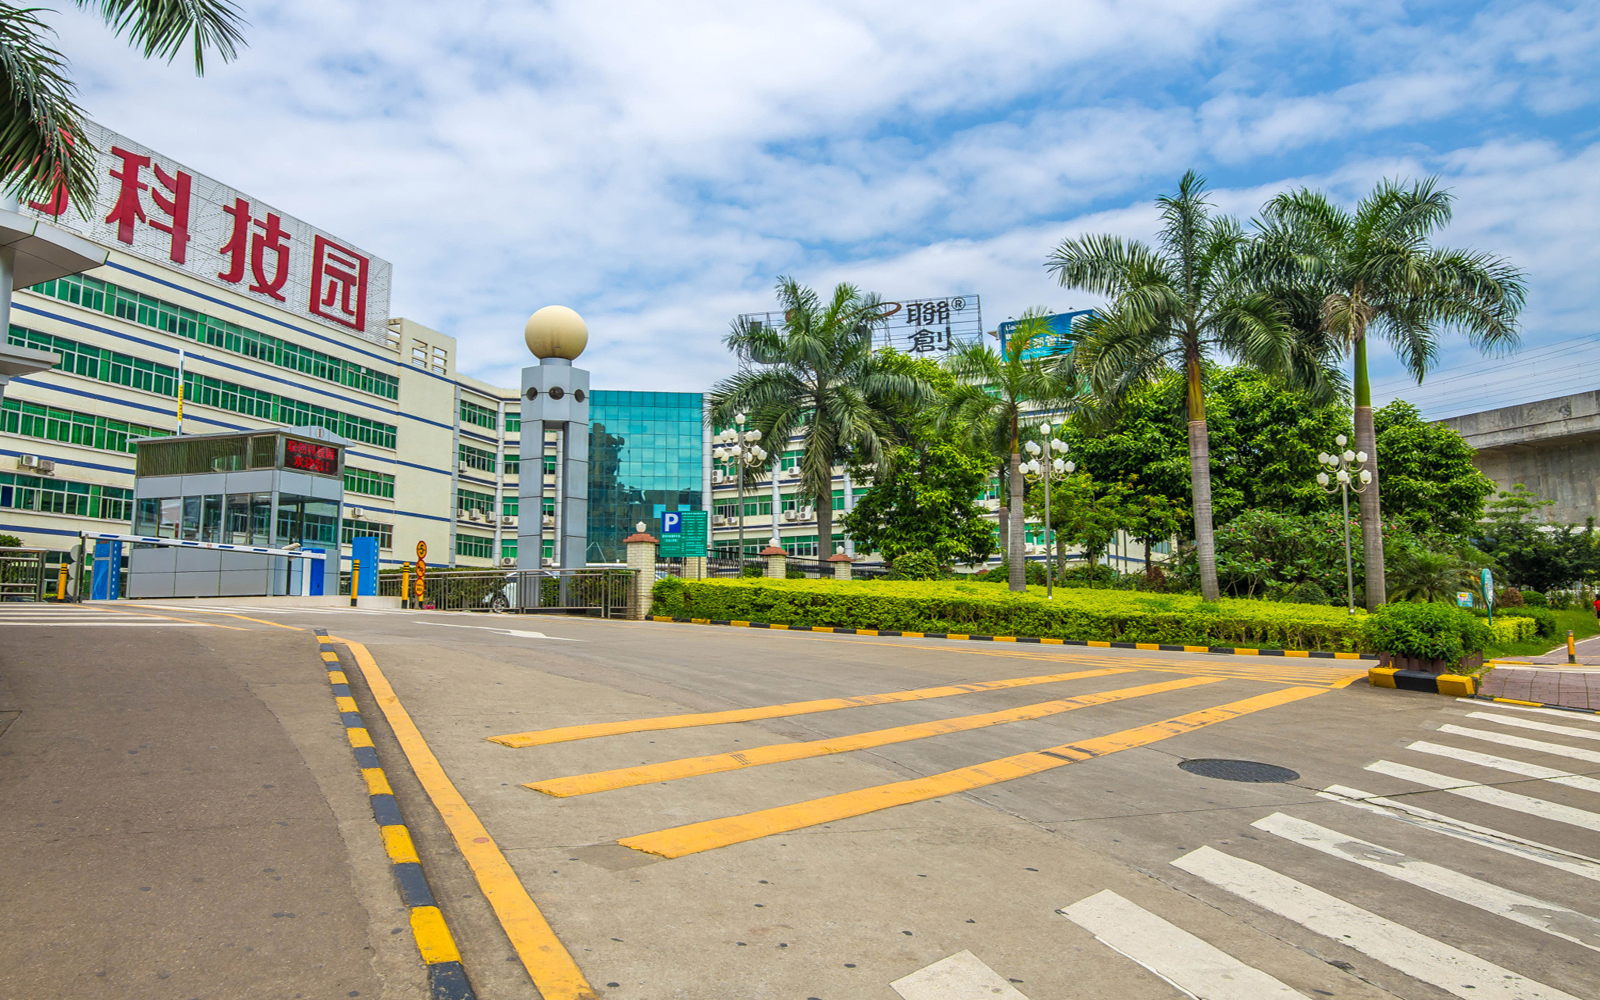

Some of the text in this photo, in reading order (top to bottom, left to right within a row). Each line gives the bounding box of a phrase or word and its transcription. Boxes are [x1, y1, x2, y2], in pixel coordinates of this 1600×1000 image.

[15, 124, 369, 332] 科技园
[287, 440, 335, 460] 联创科技园
[664, 513, 679, 532] P
